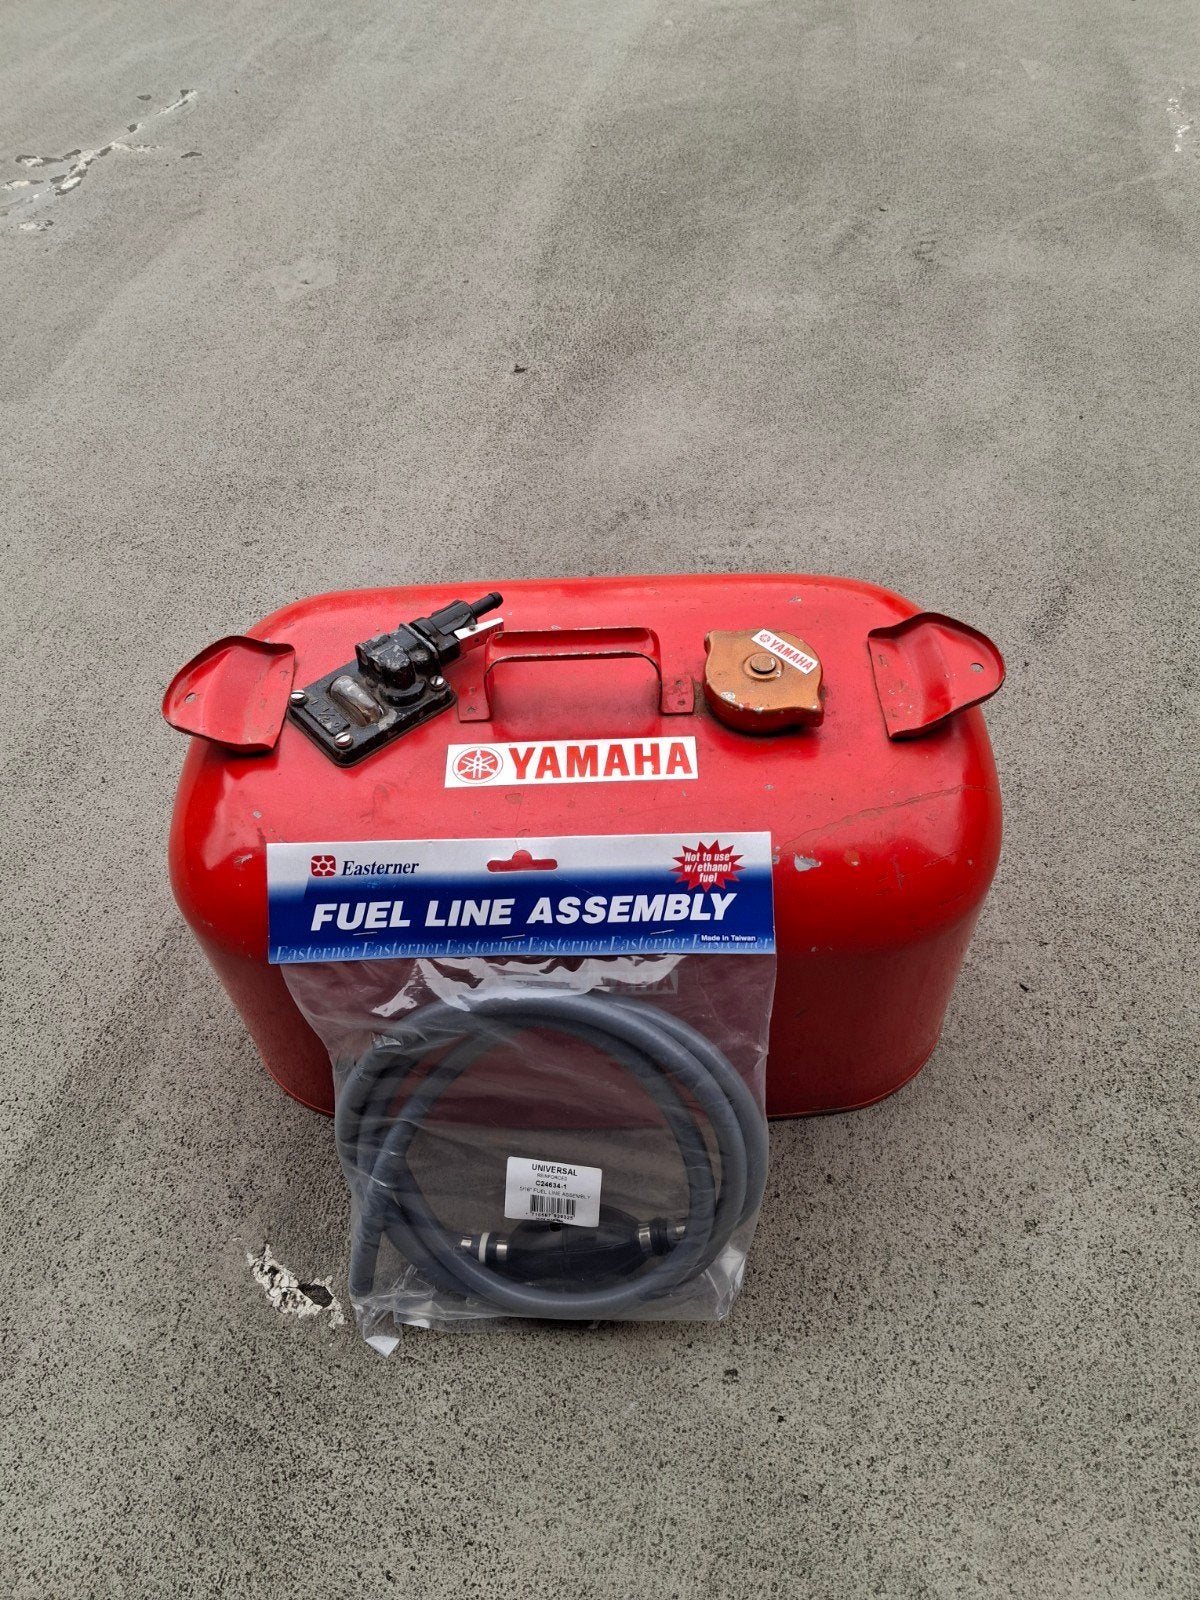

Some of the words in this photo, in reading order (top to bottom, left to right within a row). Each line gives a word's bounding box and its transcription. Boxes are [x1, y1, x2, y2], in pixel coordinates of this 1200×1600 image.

[769, 639, 814, 671] YAMAHA
[508, 742, 693, 780] YAMAHA
[684, 851, 700, 862] Not
[702, 852, 711, 862] to
[714, 852, 730, 862] use
[341, 860, 419, 876] Easterner
[684, 861, 731, 872] w/ethanol
[699, 872, 718, 883] fuel
[310, 900, 411, 931] FUEL
[425, 898, 515, 927] LINE
[526, 893, 738, 924] ASSEMBLY
[701, 934, 720, 942] Made
[722, 934, 729, 942] in
[731, 934, 756, 942] Taiwan
[276, 945, 359, 962] Easterner
[362, 941, 443, 958] Easterner
[445, 938, 525, 956] Easterner
[528, 935, 607, 953] Easterner
[609, 934, 689, 952] Easterner
[531, 1164, 578, 1176] UNIVERSAL
[535, 1180, 567, 1190] C24634-1
